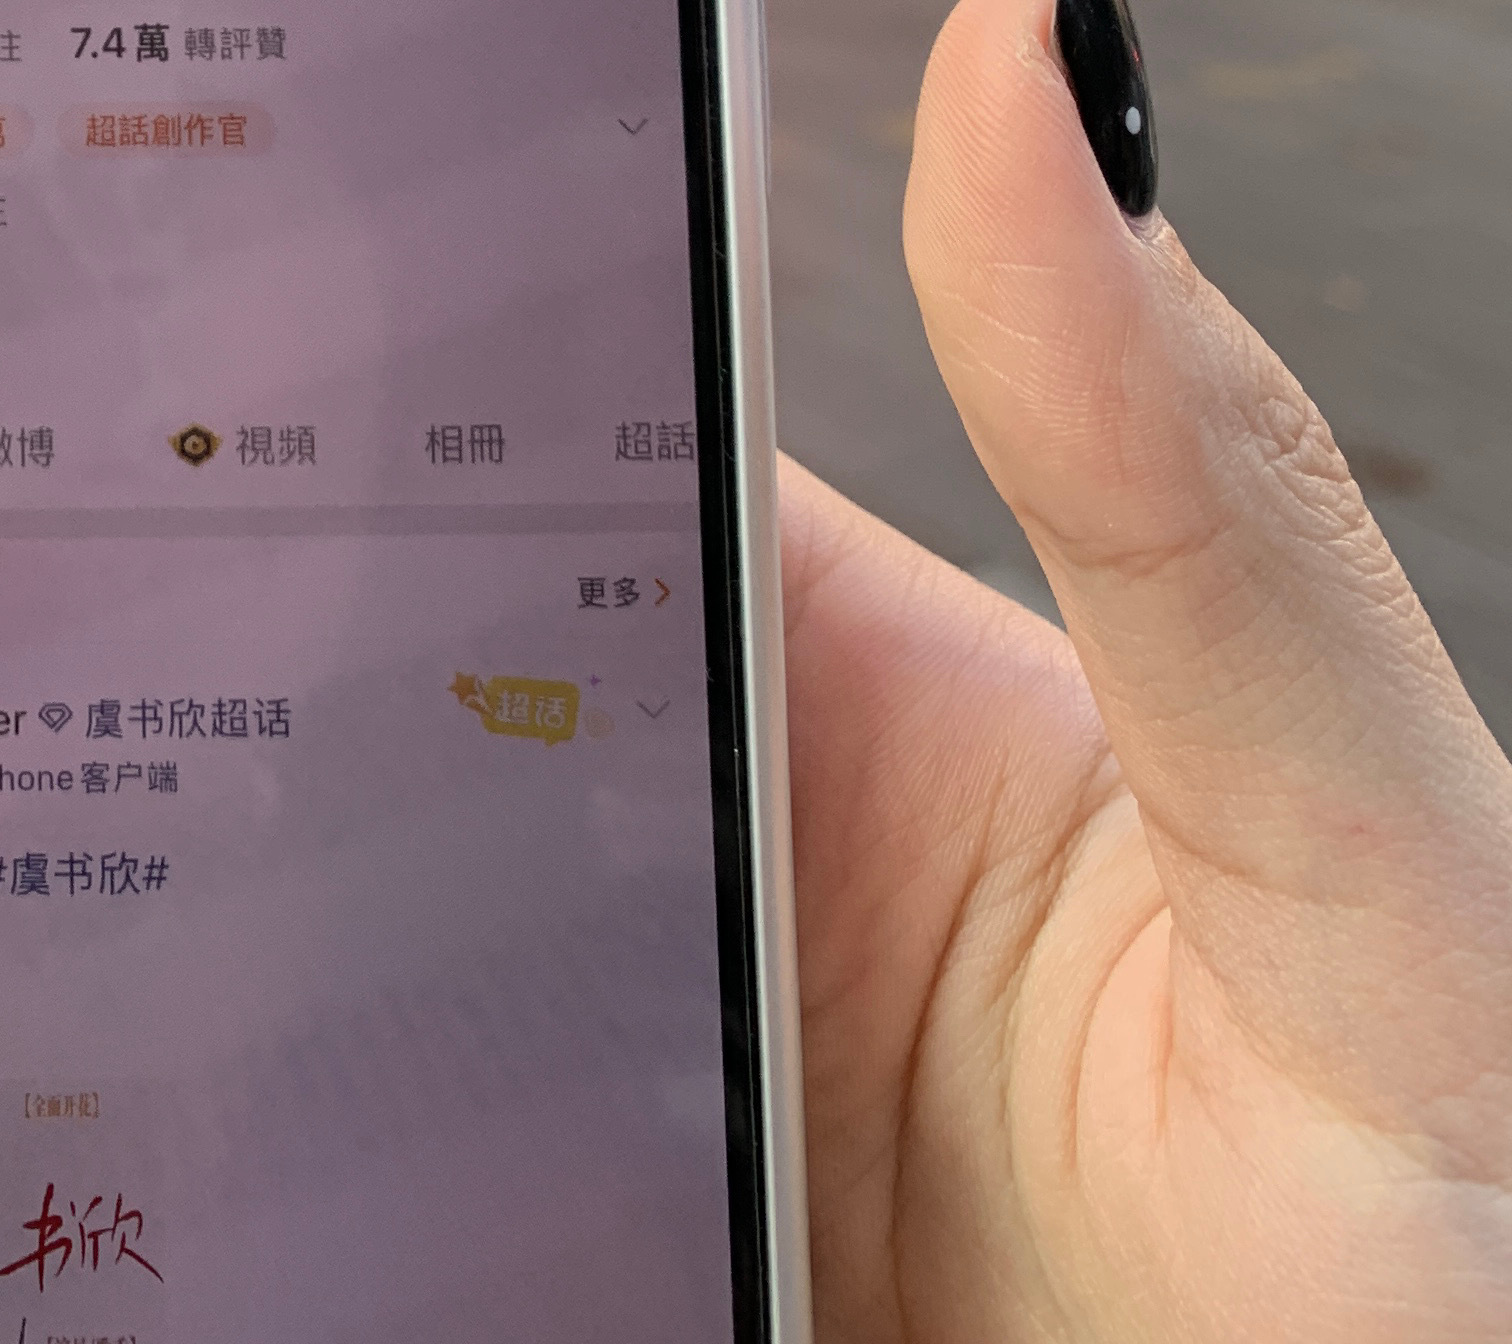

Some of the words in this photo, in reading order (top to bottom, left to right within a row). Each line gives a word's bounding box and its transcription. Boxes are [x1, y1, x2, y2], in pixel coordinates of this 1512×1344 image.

[85, 112, 248, 148] 超話創作官
[235, 423, 318, 467] 視頻
[424, 422, 506, 466] 相冊
[614, 419, 697, 463] 超話
[575, 575, 641, 610] 更多
[83, 696, 292, 740] 虞书欣超话
[495, 689, 568, 729] 超话
